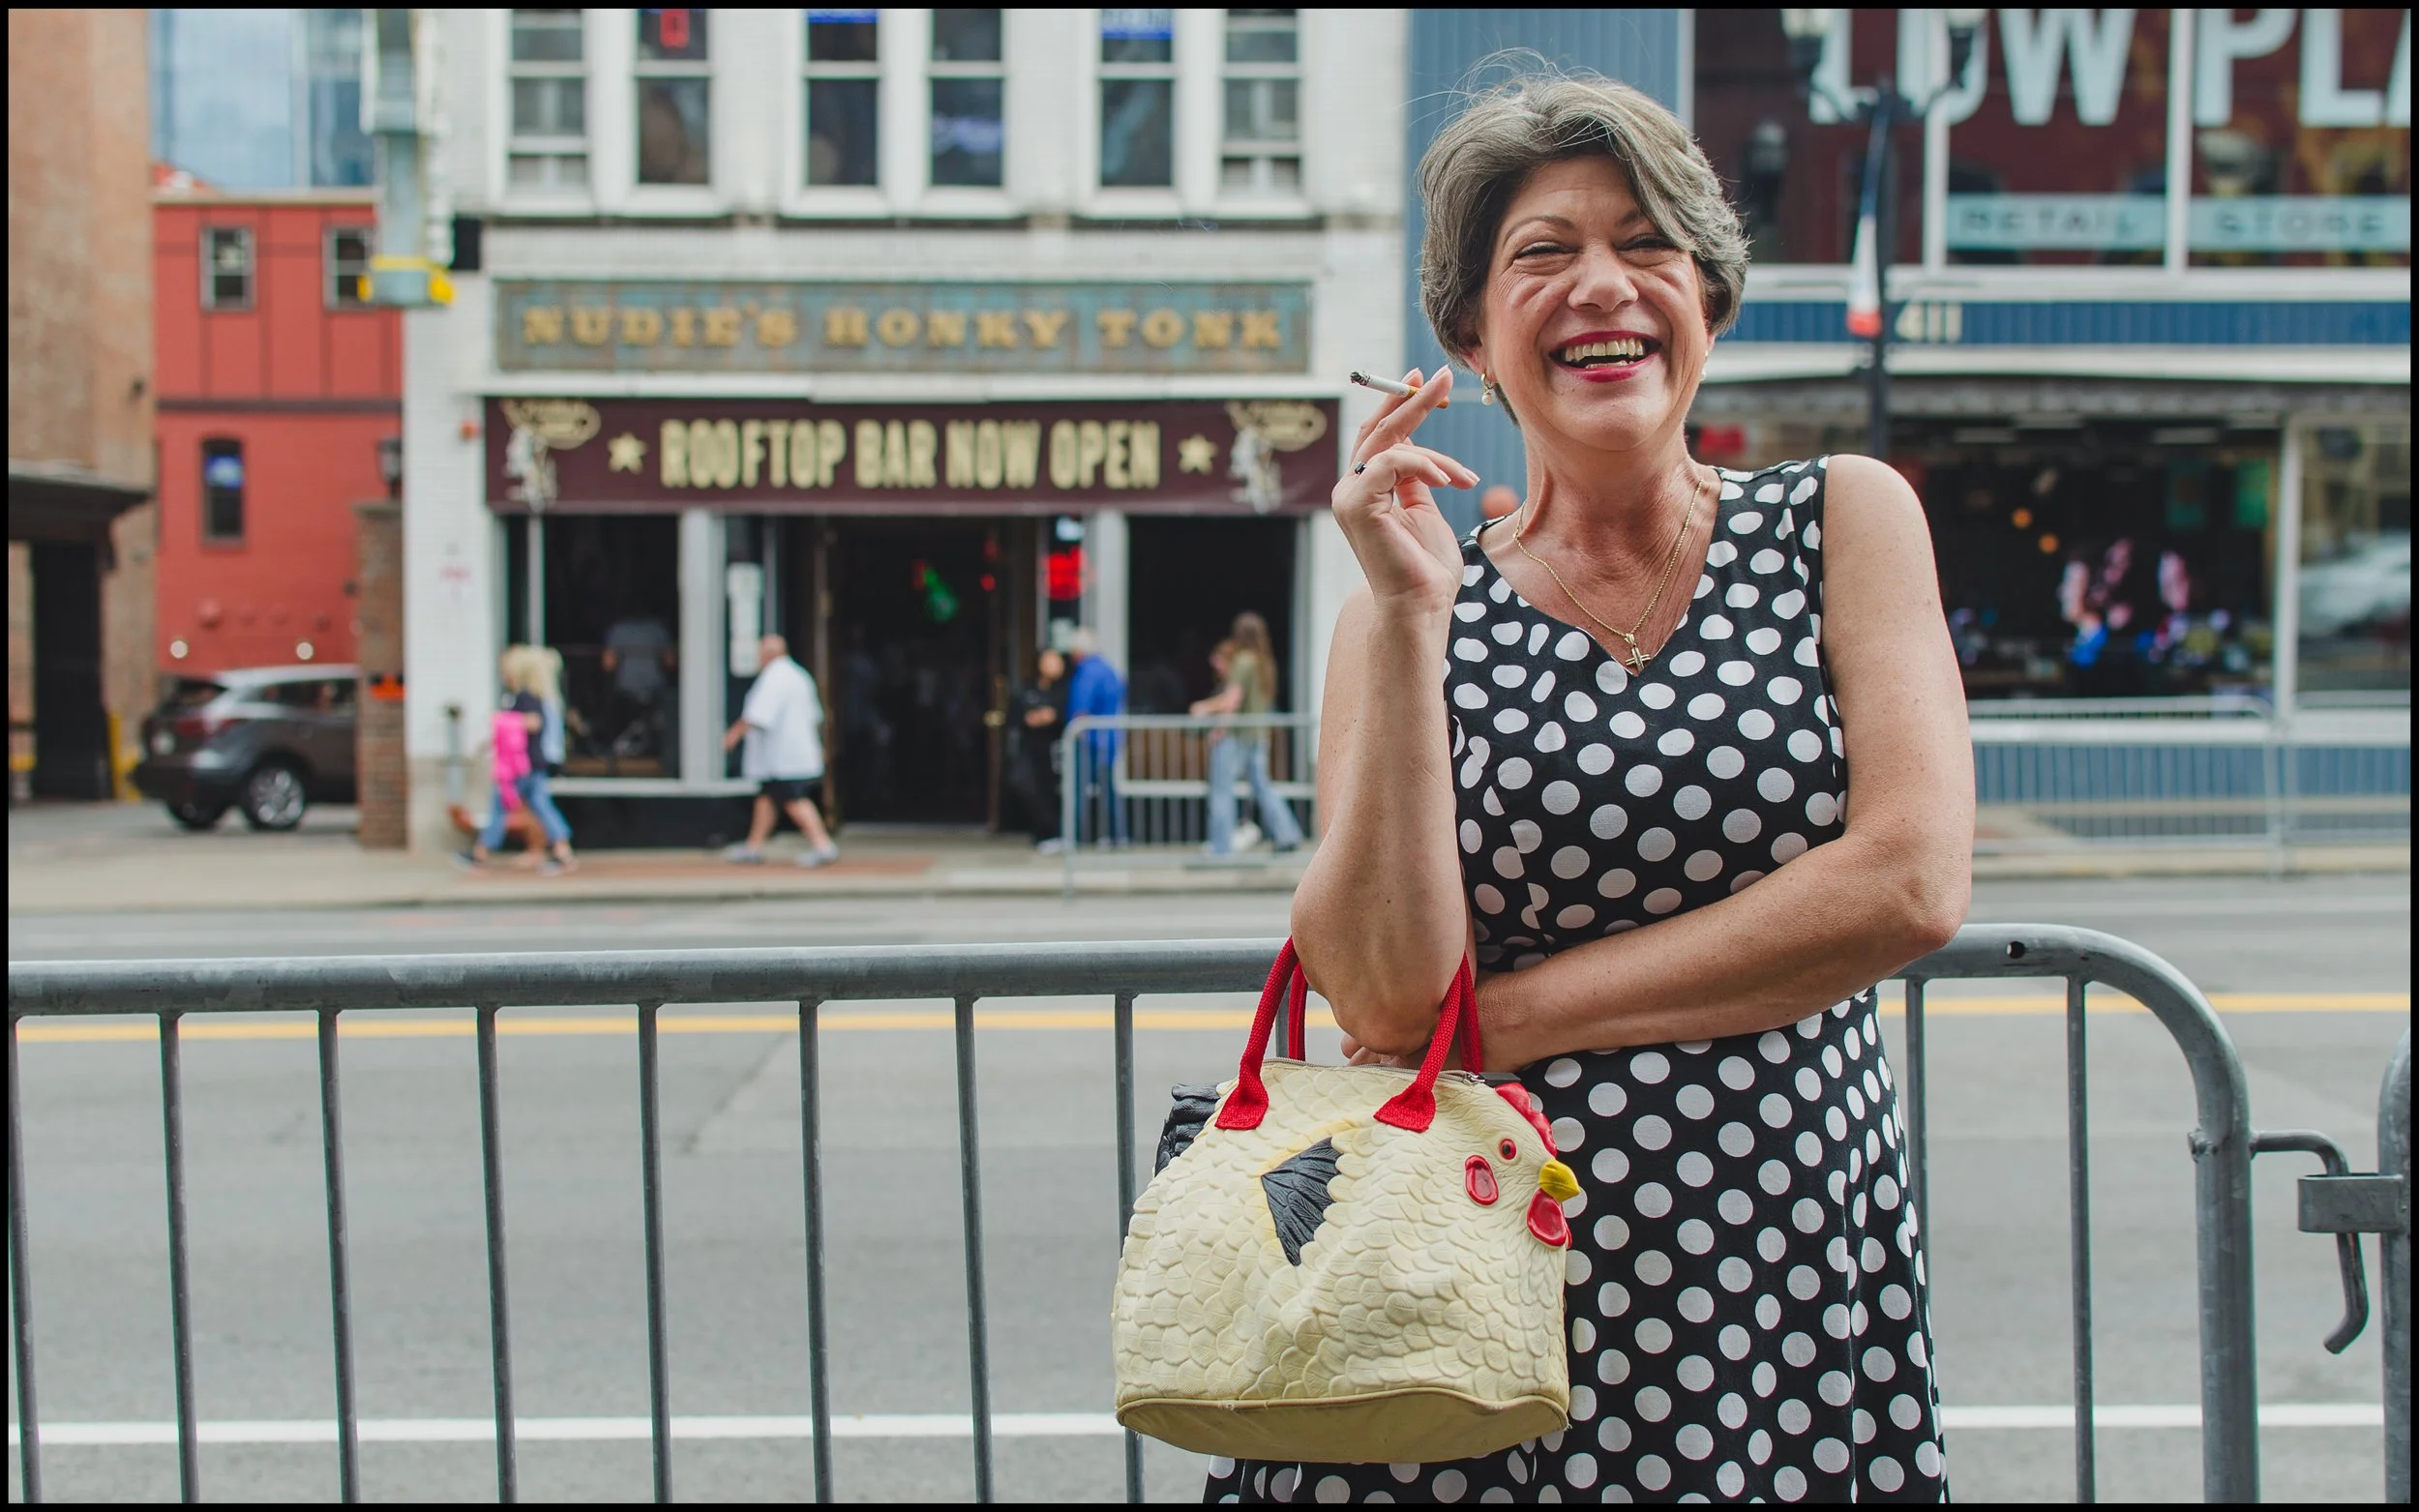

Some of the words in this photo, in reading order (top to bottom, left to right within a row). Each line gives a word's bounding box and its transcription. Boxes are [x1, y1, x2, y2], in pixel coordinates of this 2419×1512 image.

[523, 302, 797, 345] NUDIE'S
[824, 307, 1066, 347] HONKY
[1097, 309, 1281, 347] TONK
[1896, 303, 1962, 341] 411
[660, 419, 846, 489] ROOFTOP
[855, 419, 938, 488] BAR
[945, 419, 1041, 489] NOW
[1049, 419, 1159, 489] OPEN
